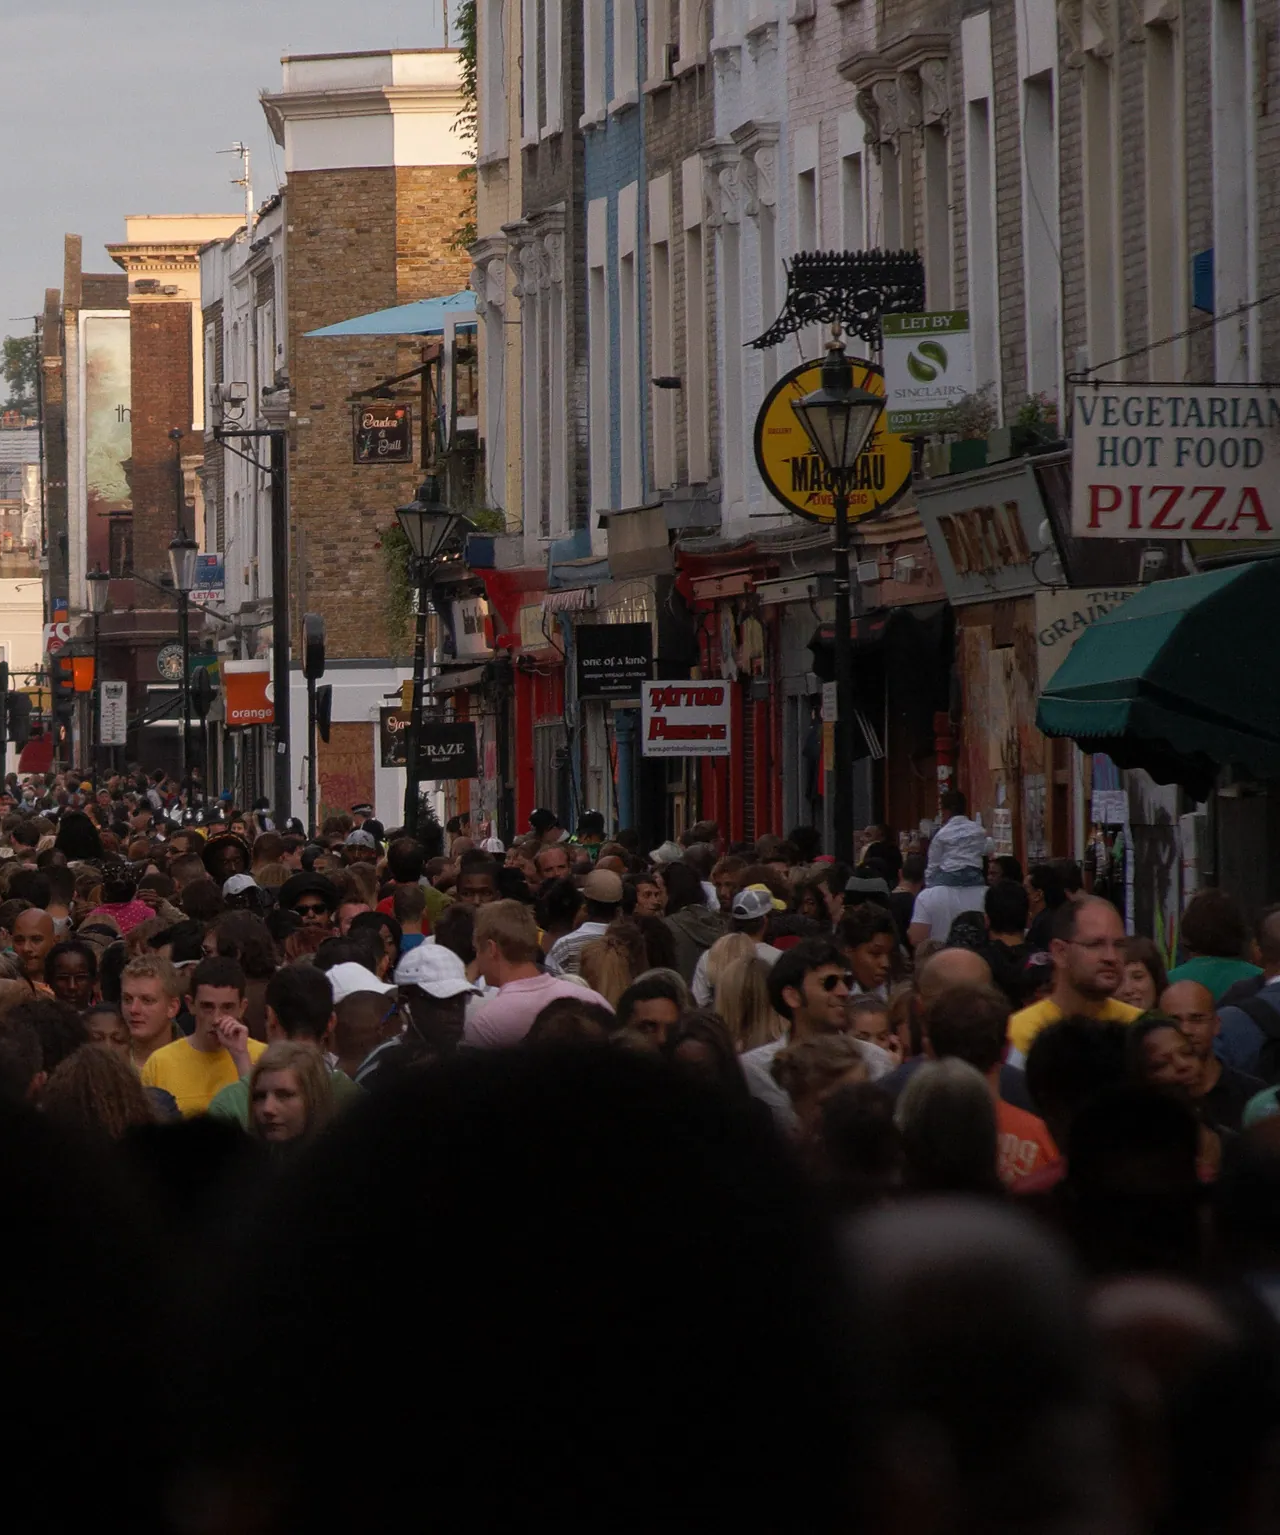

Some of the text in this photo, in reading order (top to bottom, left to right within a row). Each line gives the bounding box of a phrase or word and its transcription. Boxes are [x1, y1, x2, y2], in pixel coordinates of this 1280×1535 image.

[901, 315, 953, 329] LET BY
[894, 385, 967, 398] SINCLAIRS
[891, 414, 913, 424] 020
[1097, 436, 1264, 468] HOT FOOD
[1087, 484, 1273, 530] PIZZA
[583, 656, 647, 667] one of a kind
[232, 708, 272, 719] orange
